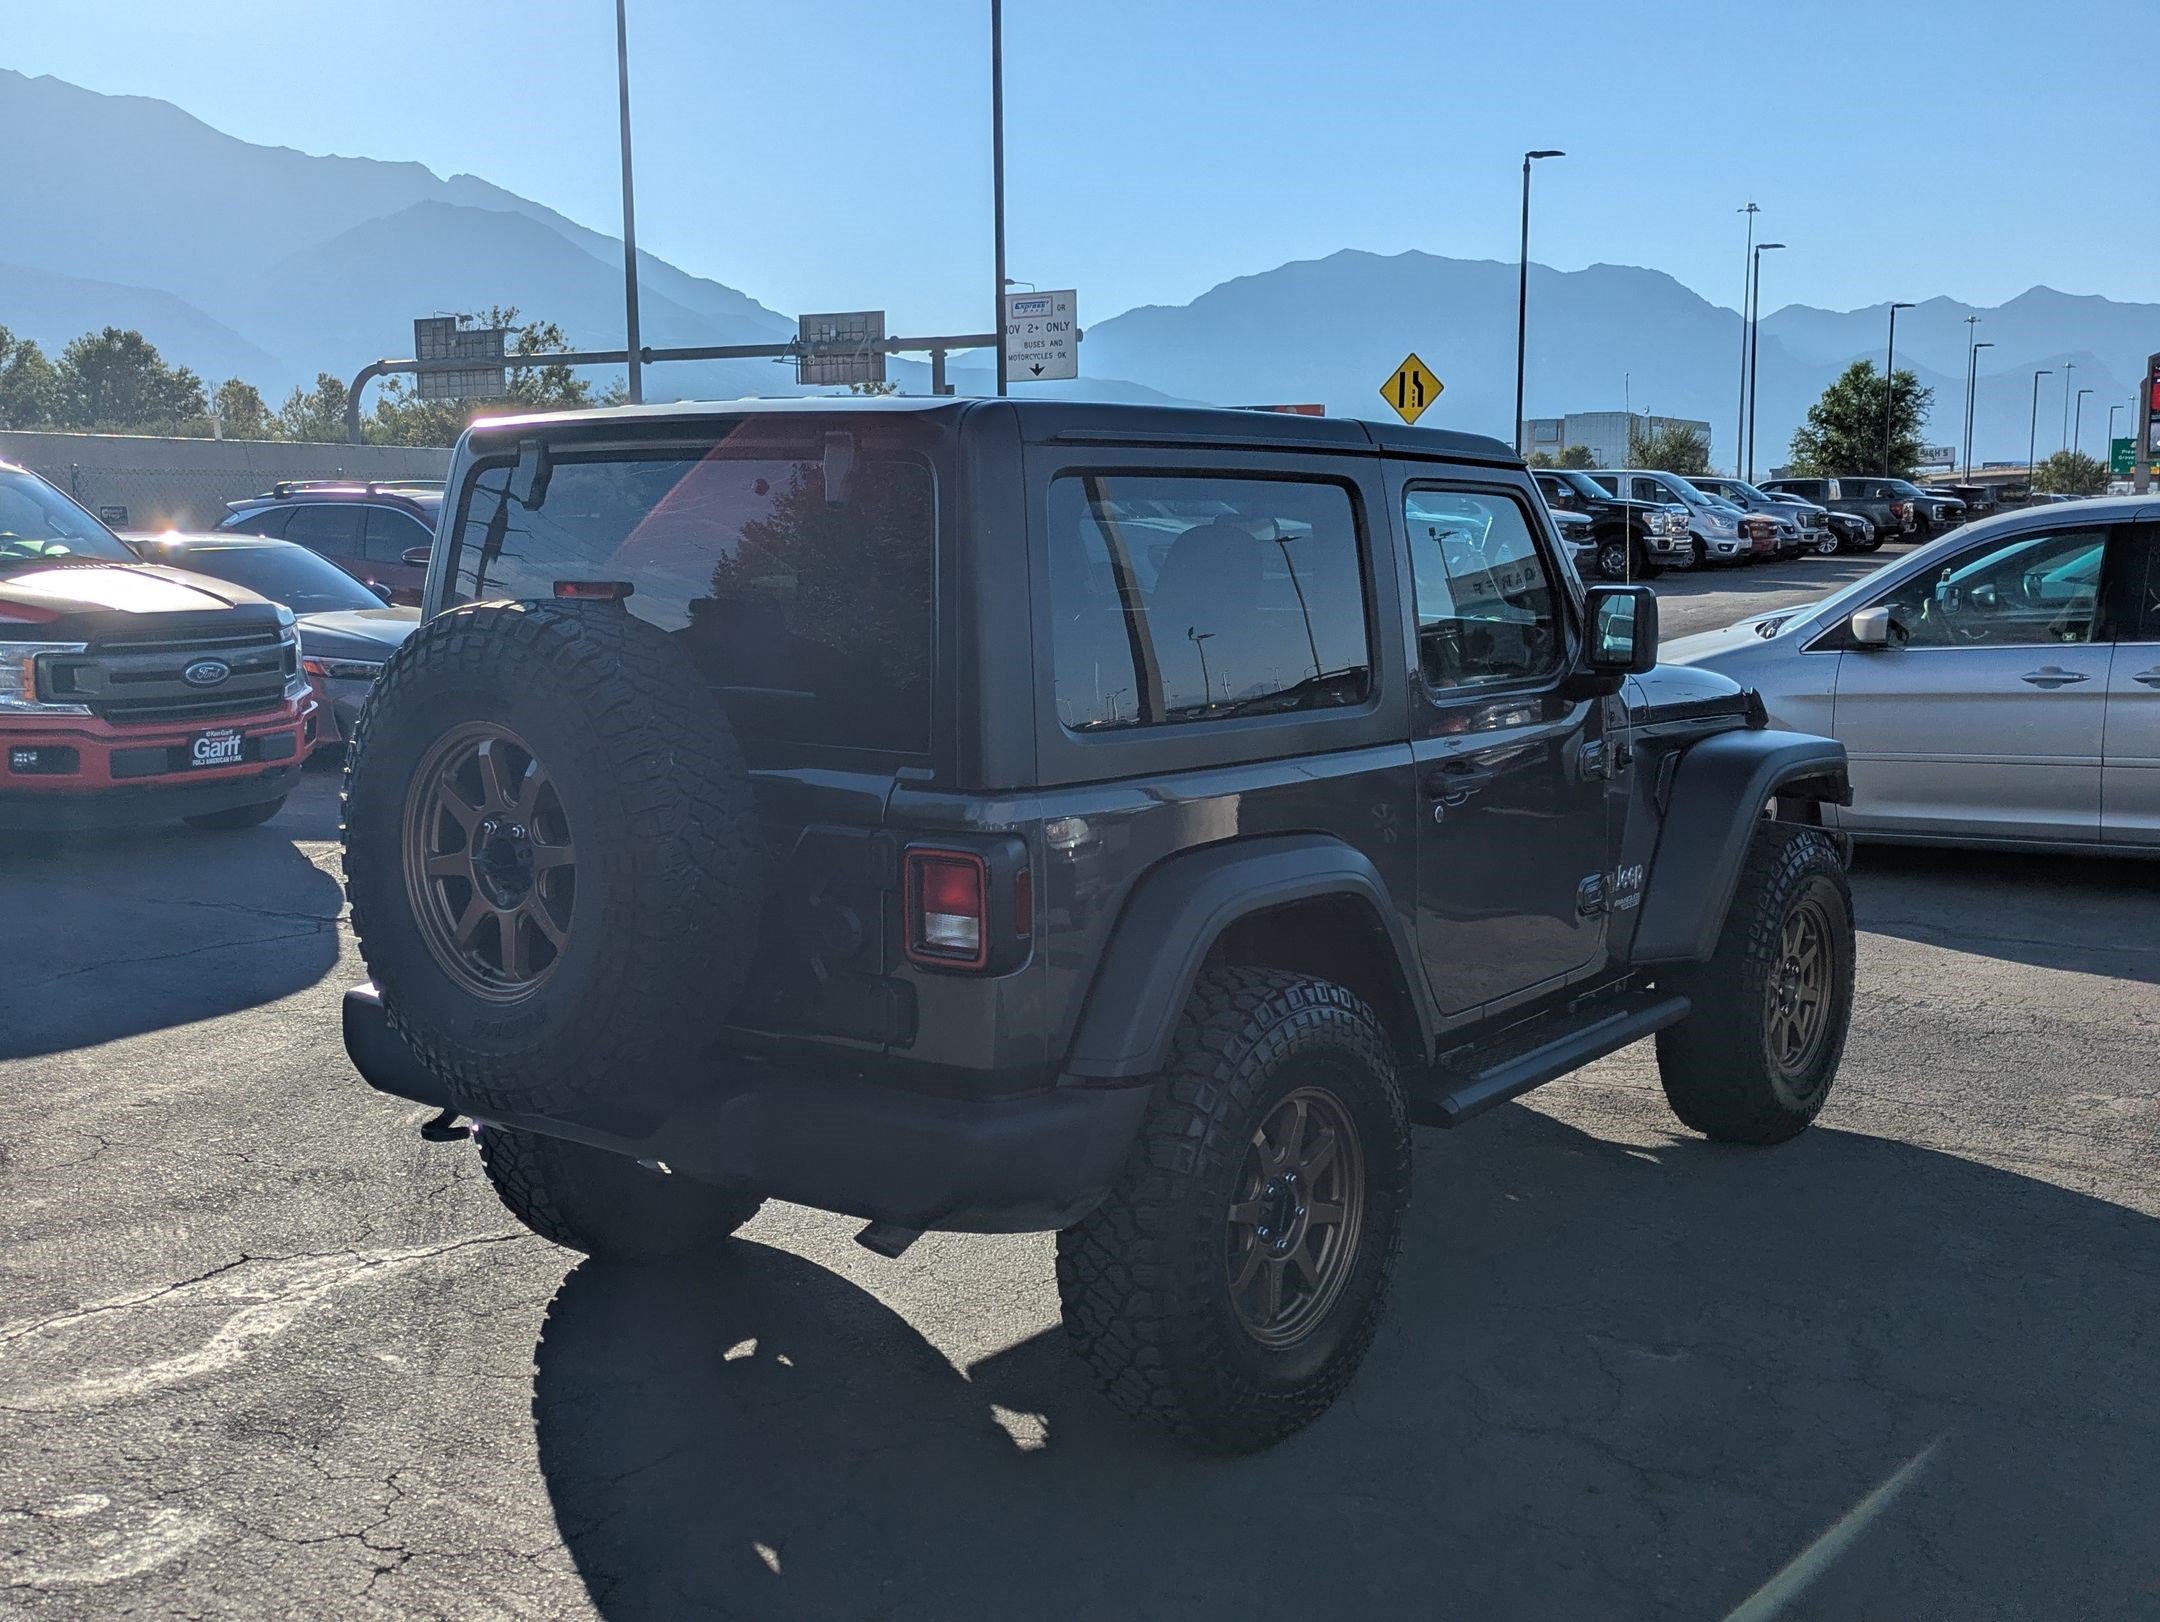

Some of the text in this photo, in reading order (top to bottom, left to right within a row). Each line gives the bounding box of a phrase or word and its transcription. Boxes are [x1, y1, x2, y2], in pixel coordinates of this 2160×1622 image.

[1056, 303, 1066, 312] OR
[1027, 323, 1039, 333] 2+
[1046, 321, 1070, 332] ONLY
[1024, 339, 1063, 349] BUSES AND
[1008, 351, 1067, 361] MOTORCYCLES OK
[193, 735, 241, 759] Garff
[1616, 864, 1644, 889] Jeep
